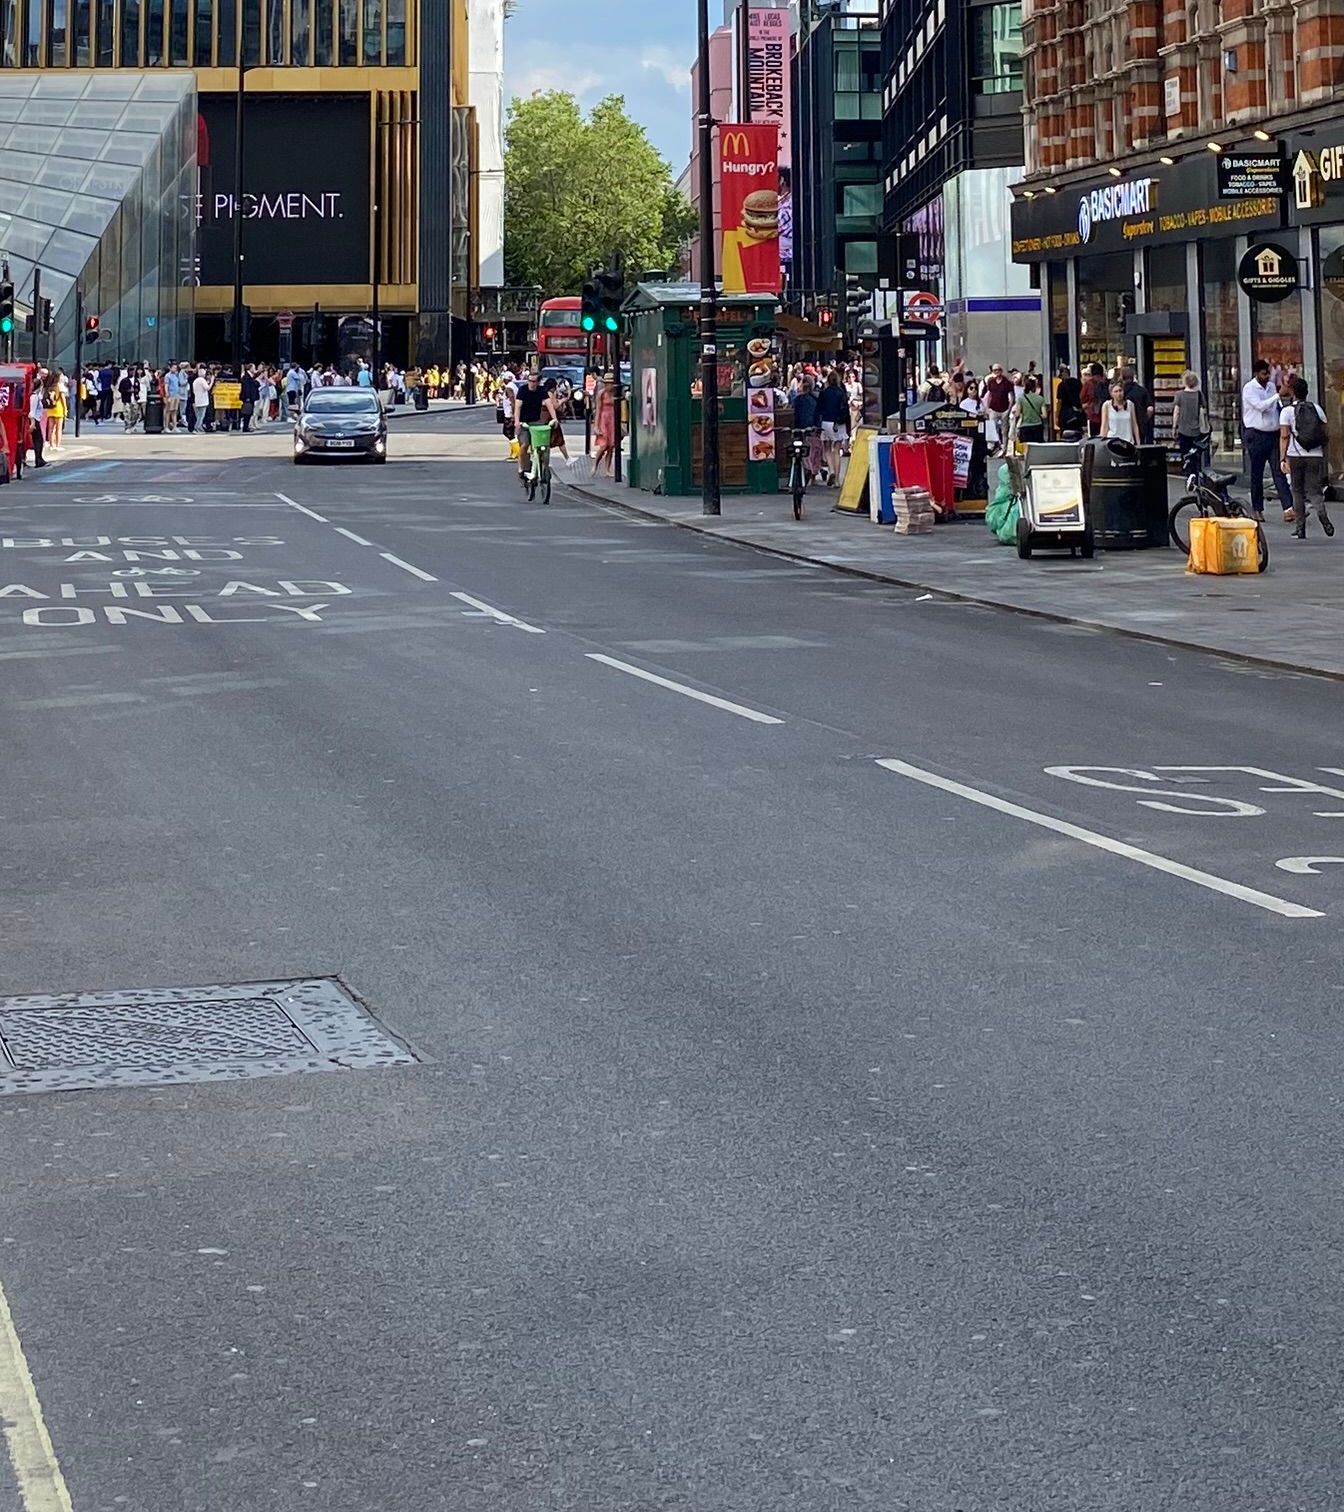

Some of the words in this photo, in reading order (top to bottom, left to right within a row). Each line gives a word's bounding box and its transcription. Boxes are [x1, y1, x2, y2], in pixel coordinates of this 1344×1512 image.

[749, 47, 765, 112] MOUNTAIN
[765, 43, 784, 118] BROKEBACK
[722, 161, 775, 176] Hungry?
[1232, 159, 1281, 168] BASICMART
[214, 193, 344, 218] PIGMENT.
[1091, 178, 1151, 222] BASICMART
[1159, 213, 1185, 232] TOBACCO
[1188, 209, 1206, 227] VAPES
[1209, 205, 1232, 224] MOBILE
[1232, 197, 1277, 220] ACCESSORIES
[1268, 276, 1296, 284] GIGGLES
[2, 534, 285, 548] BUSES
[64, 549, 244, 562] AND
[22, 603, 330, 627] ONLY
